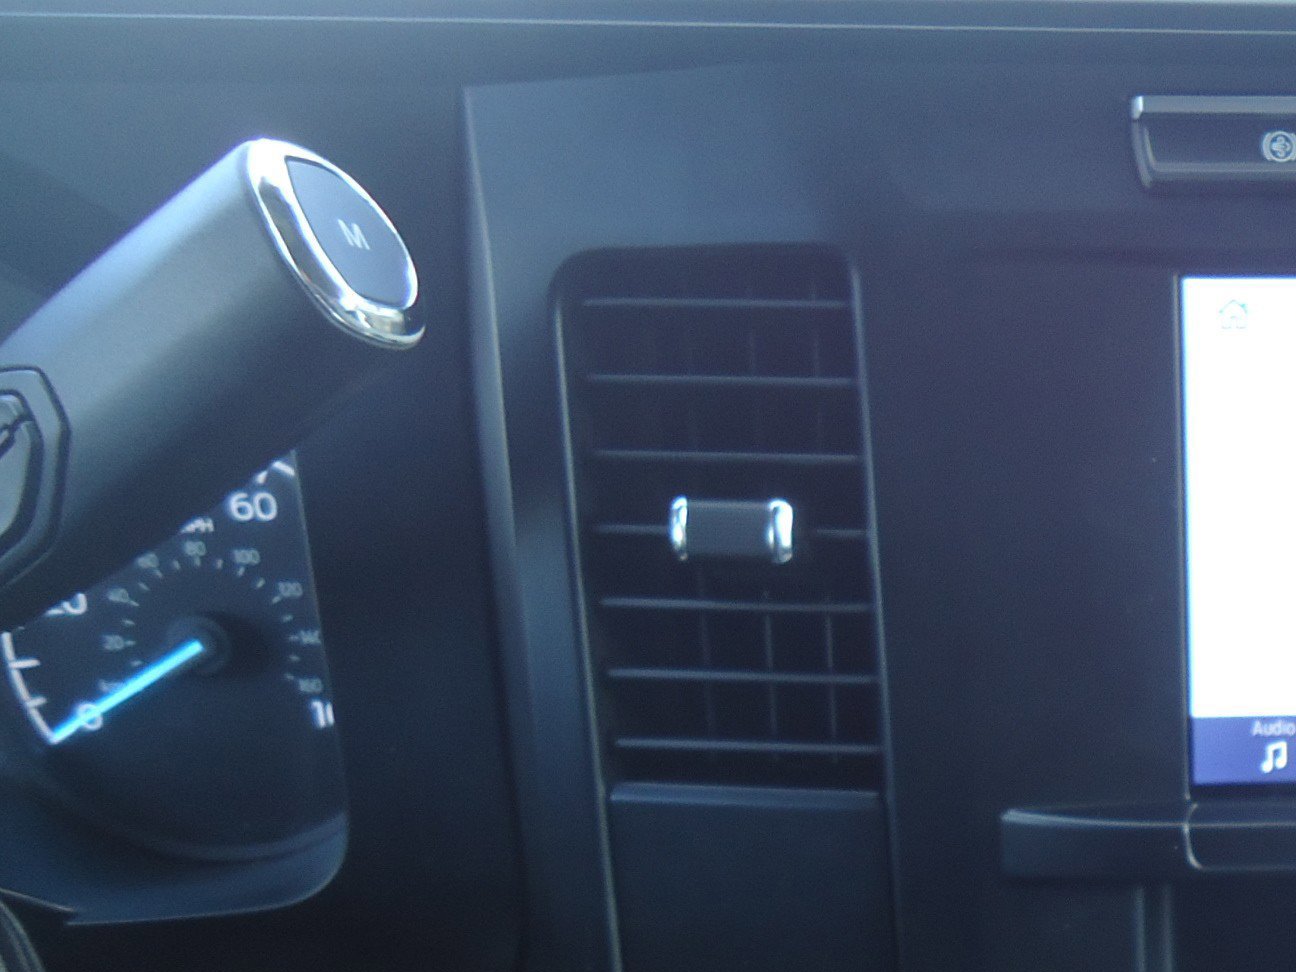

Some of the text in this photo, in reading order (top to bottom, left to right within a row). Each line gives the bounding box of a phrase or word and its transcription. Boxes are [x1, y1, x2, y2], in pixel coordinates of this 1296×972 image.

[337, 218, 370, 251] M
[228, 492, 278, 521] 60
[1252, 719, 1296, 736] Audio
